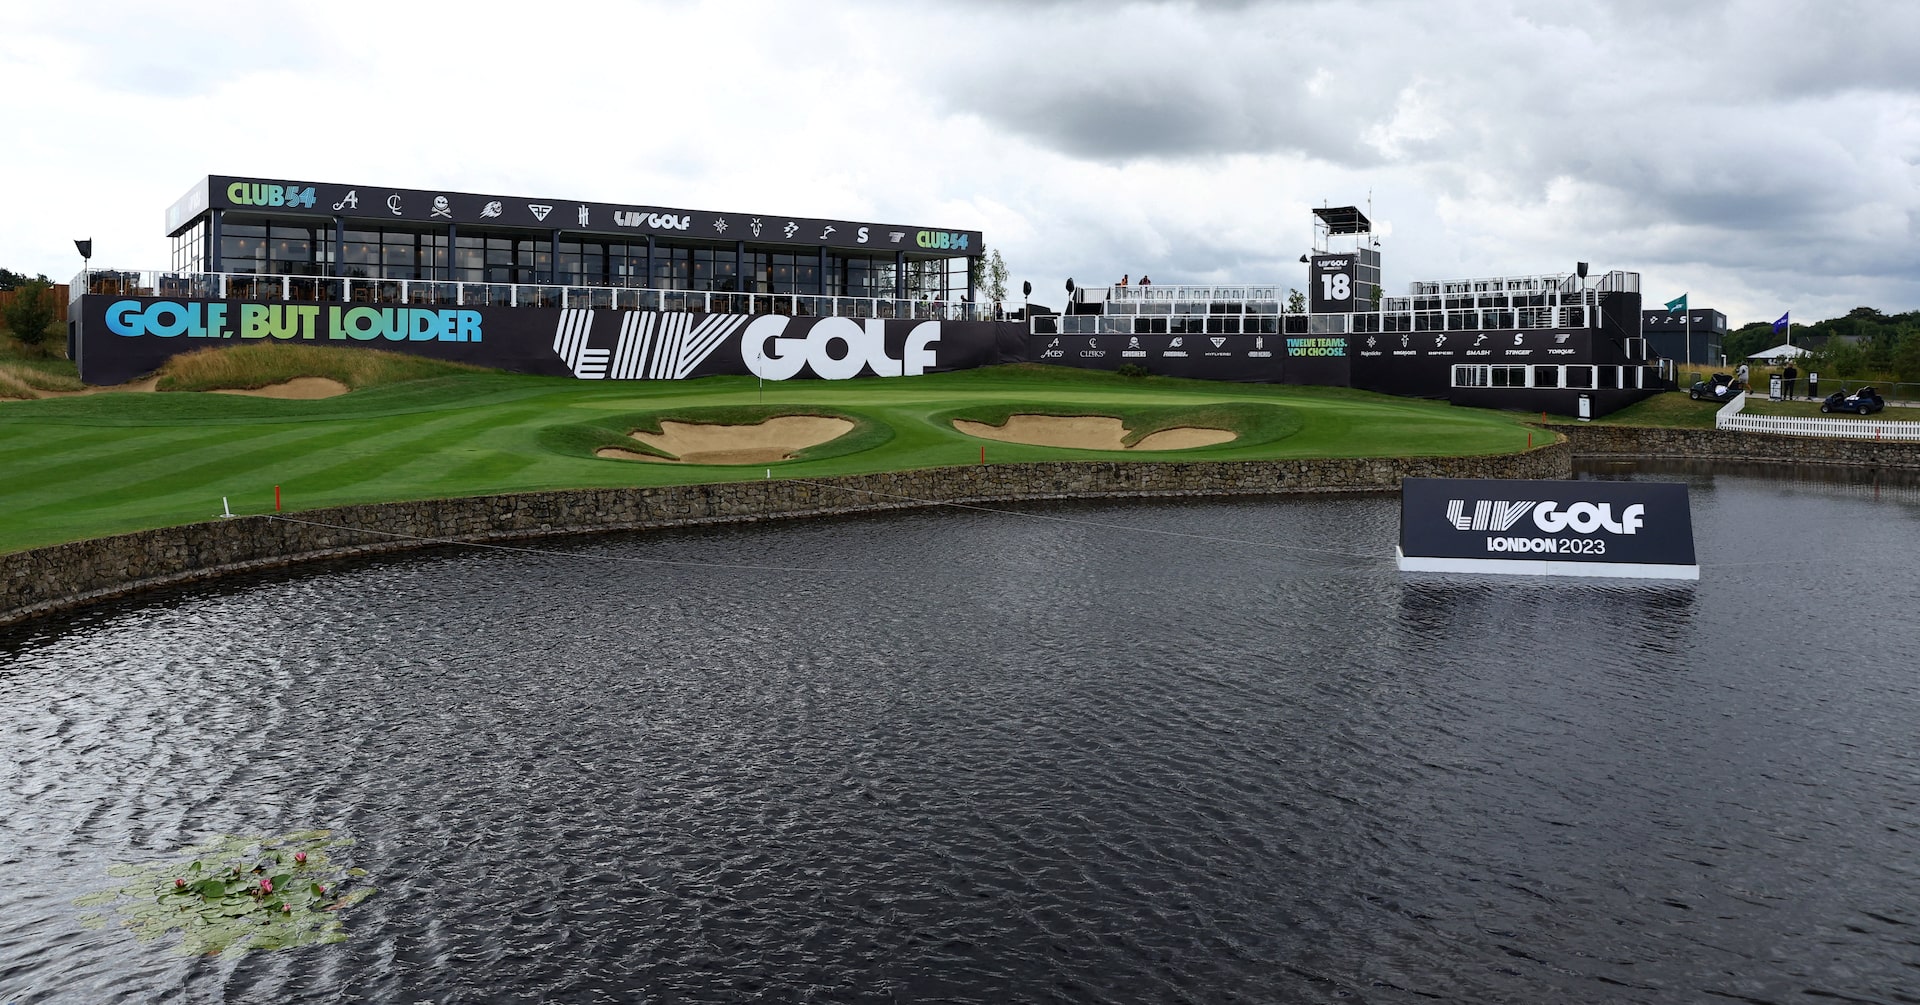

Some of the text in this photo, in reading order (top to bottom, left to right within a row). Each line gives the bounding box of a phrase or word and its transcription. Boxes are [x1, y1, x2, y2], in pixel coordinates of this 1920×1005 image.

[1321, 273, 1351, 301] 18
[240, 302, 320, 340] BUT
[328, 305, 483, 343] LOUDER
[1286, 338, 1348, 347] TWELVE TEAMS.
[1287, 347, 1346, 357] YOU CHOOSE.
[1487, 536, 1606, 555] LONDON 2023
